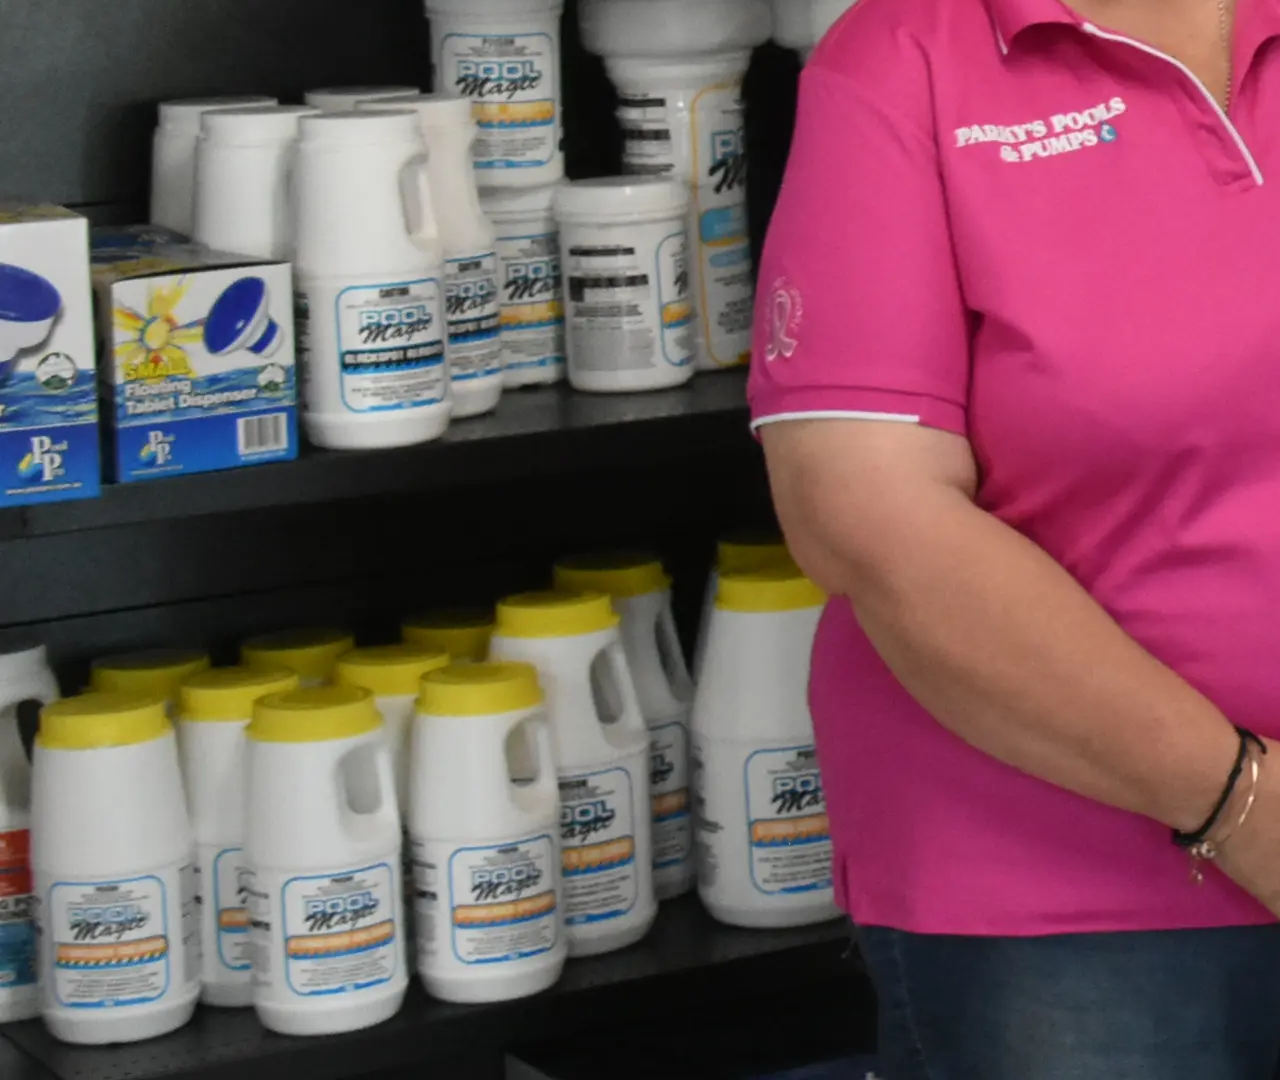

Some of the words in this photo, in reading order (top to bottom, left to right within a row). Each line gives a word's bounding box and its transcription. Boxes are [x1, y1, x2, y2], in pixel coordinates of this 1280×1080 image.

[456, 60, 543, 81] POOL
[454, 76, 542, 100] Magic
[954, 119, 1048, 148] PARKY'S
[1049, 96, 1127, 134] POOLS
[1000, 144, 1021, 162] &
[1019, 128, 1099, 162] PUMPS
[359, 305, 433, 327] POOL
[358, 323, 432, 345] Magic
[125, 380, 192, 398] Floating
[125, 397, 176, 415] Tablet
[178, 387, 259, 408] Dispenser
[472, 862, 543, 884] POOL
[470, 878, 540, 902] Magic
[67, 904, 150, 924] POOL
[305, 890, 380, 915] POOL
[69, 918, 147, 941] Magic
[303, 910, 377, 933] Magic
